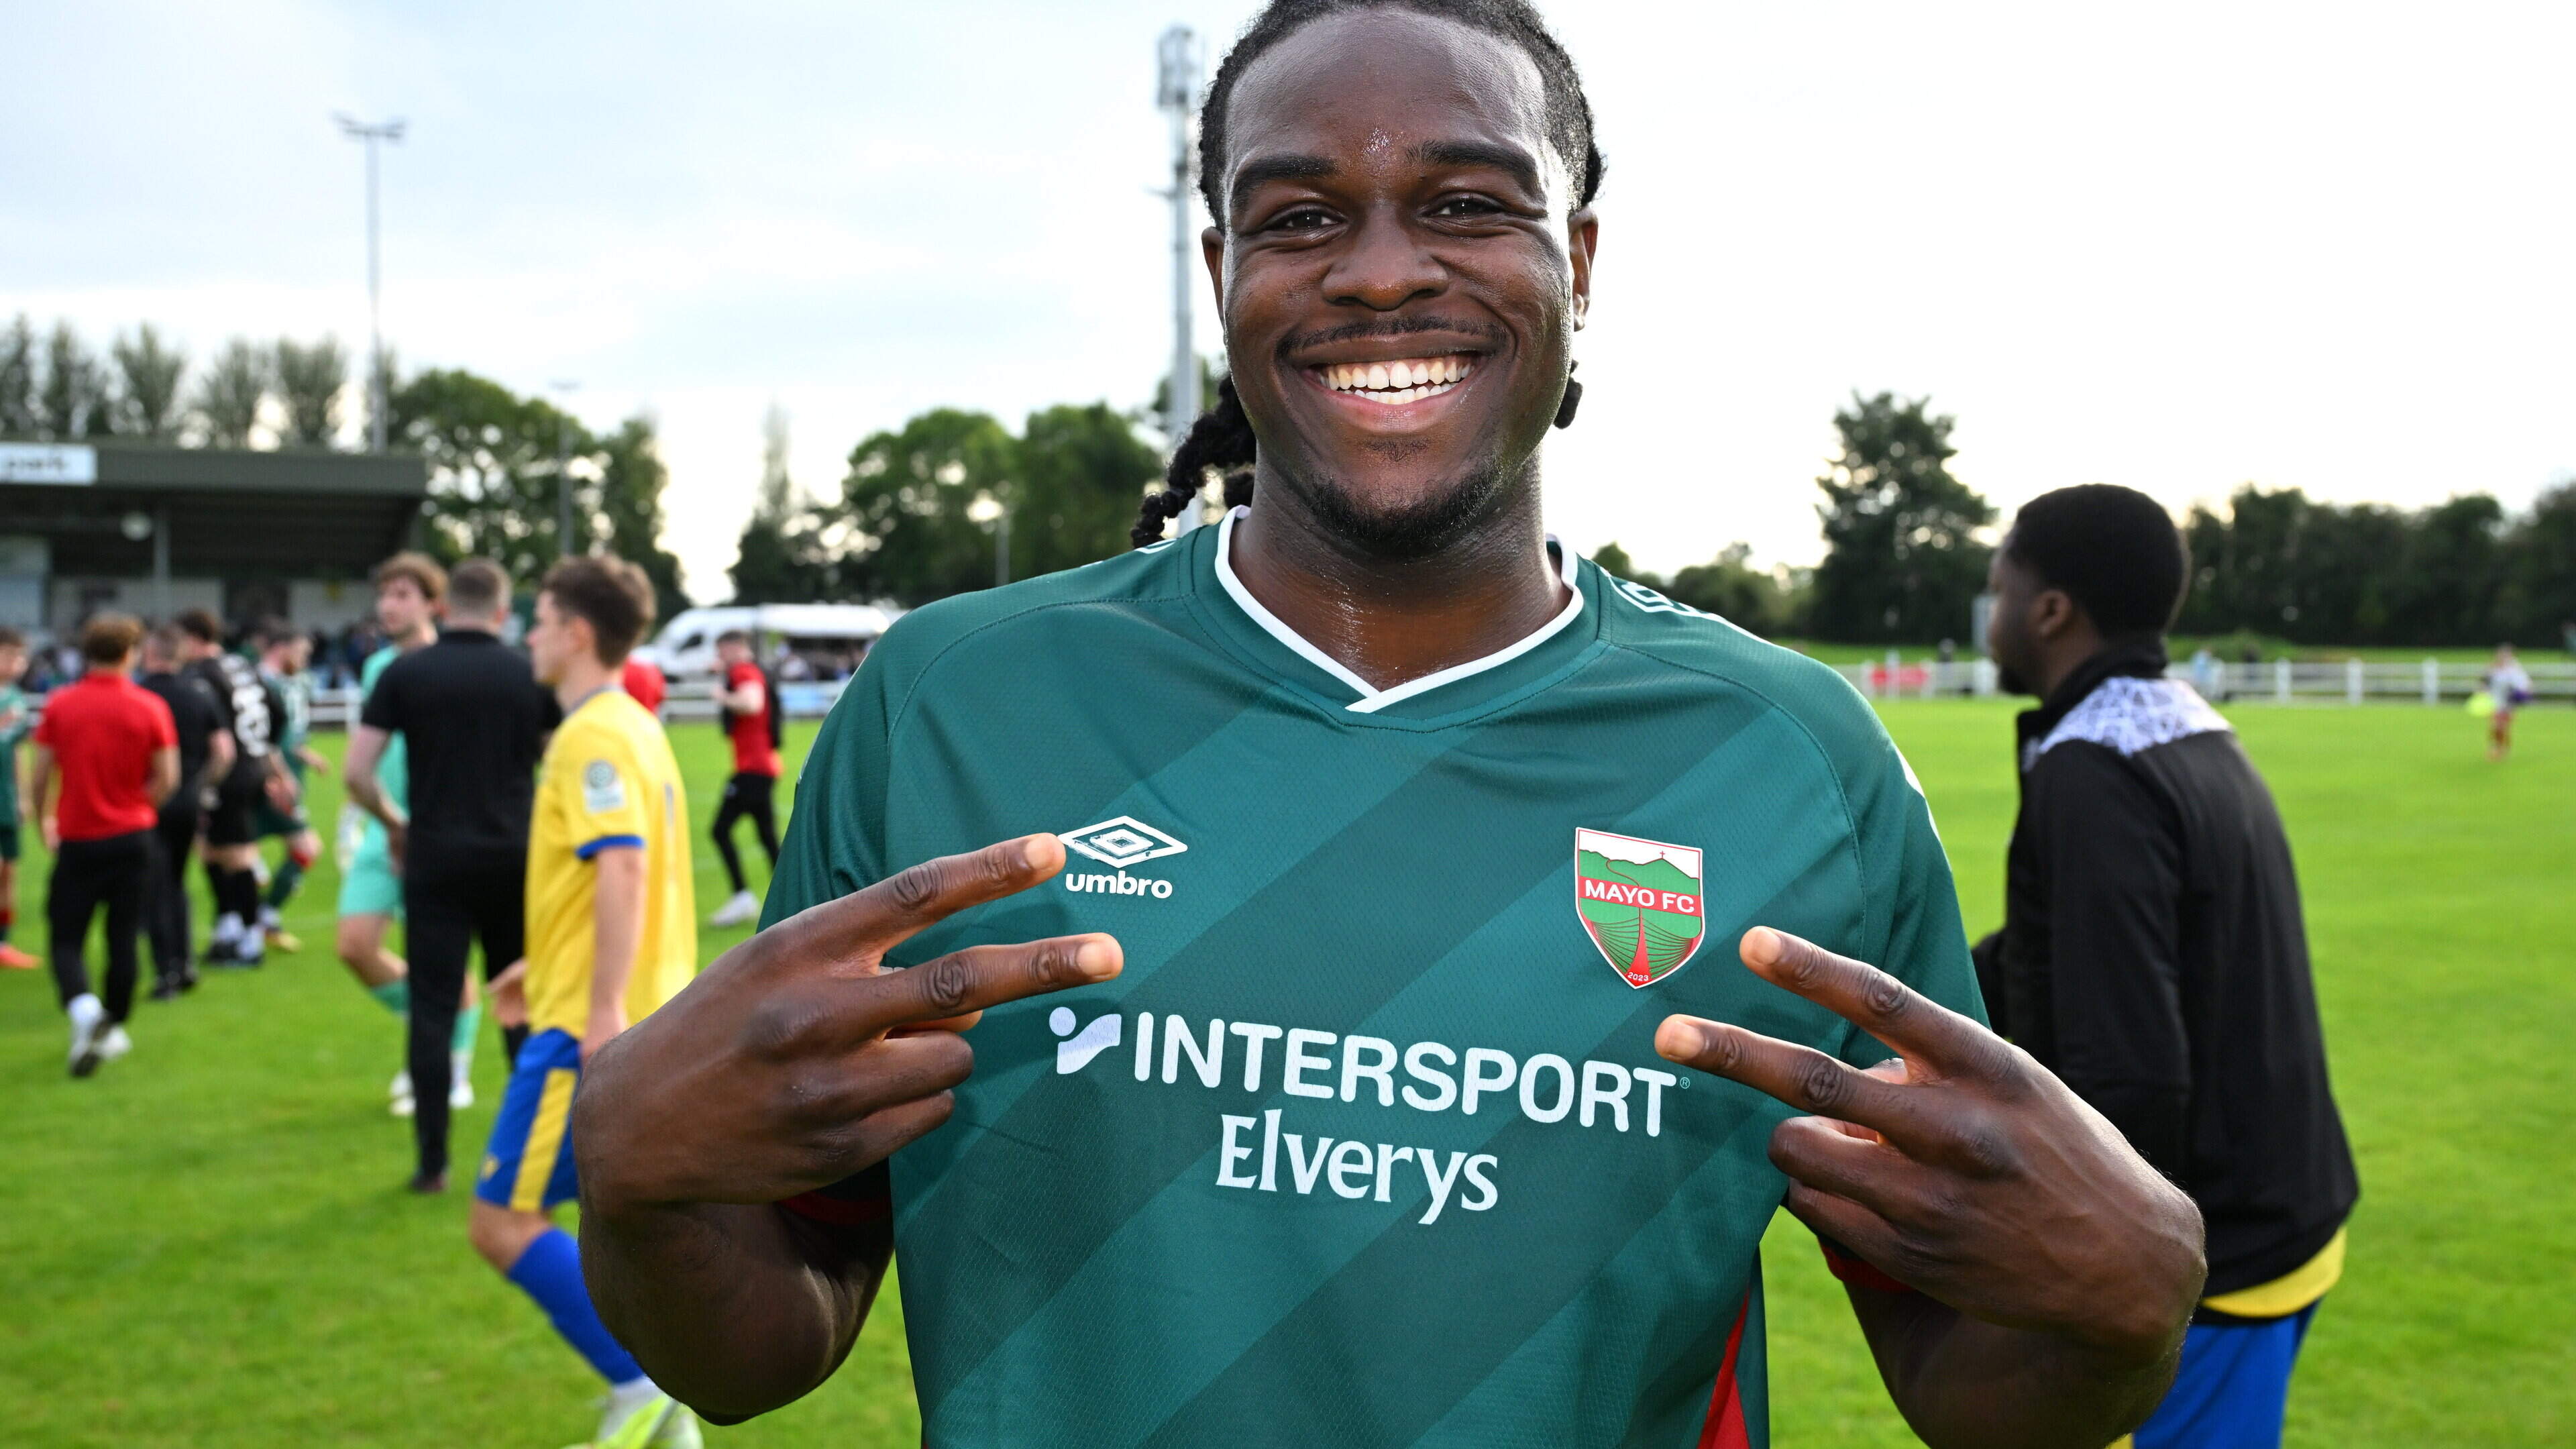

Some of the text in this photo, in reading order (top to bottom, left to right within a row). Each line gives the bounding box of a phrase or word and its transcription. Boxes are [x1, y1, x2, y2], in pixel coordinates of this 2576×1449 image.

[1065, 870, 1173, 899] umbro
[1585, 879, 1695, 913] MAYO FC
[1627, 971, 1650, 981] 2023
[1134, 1012, 1676, 1137] INTERSPORT
[1216, 1109, 1499, 1225] Elverys
